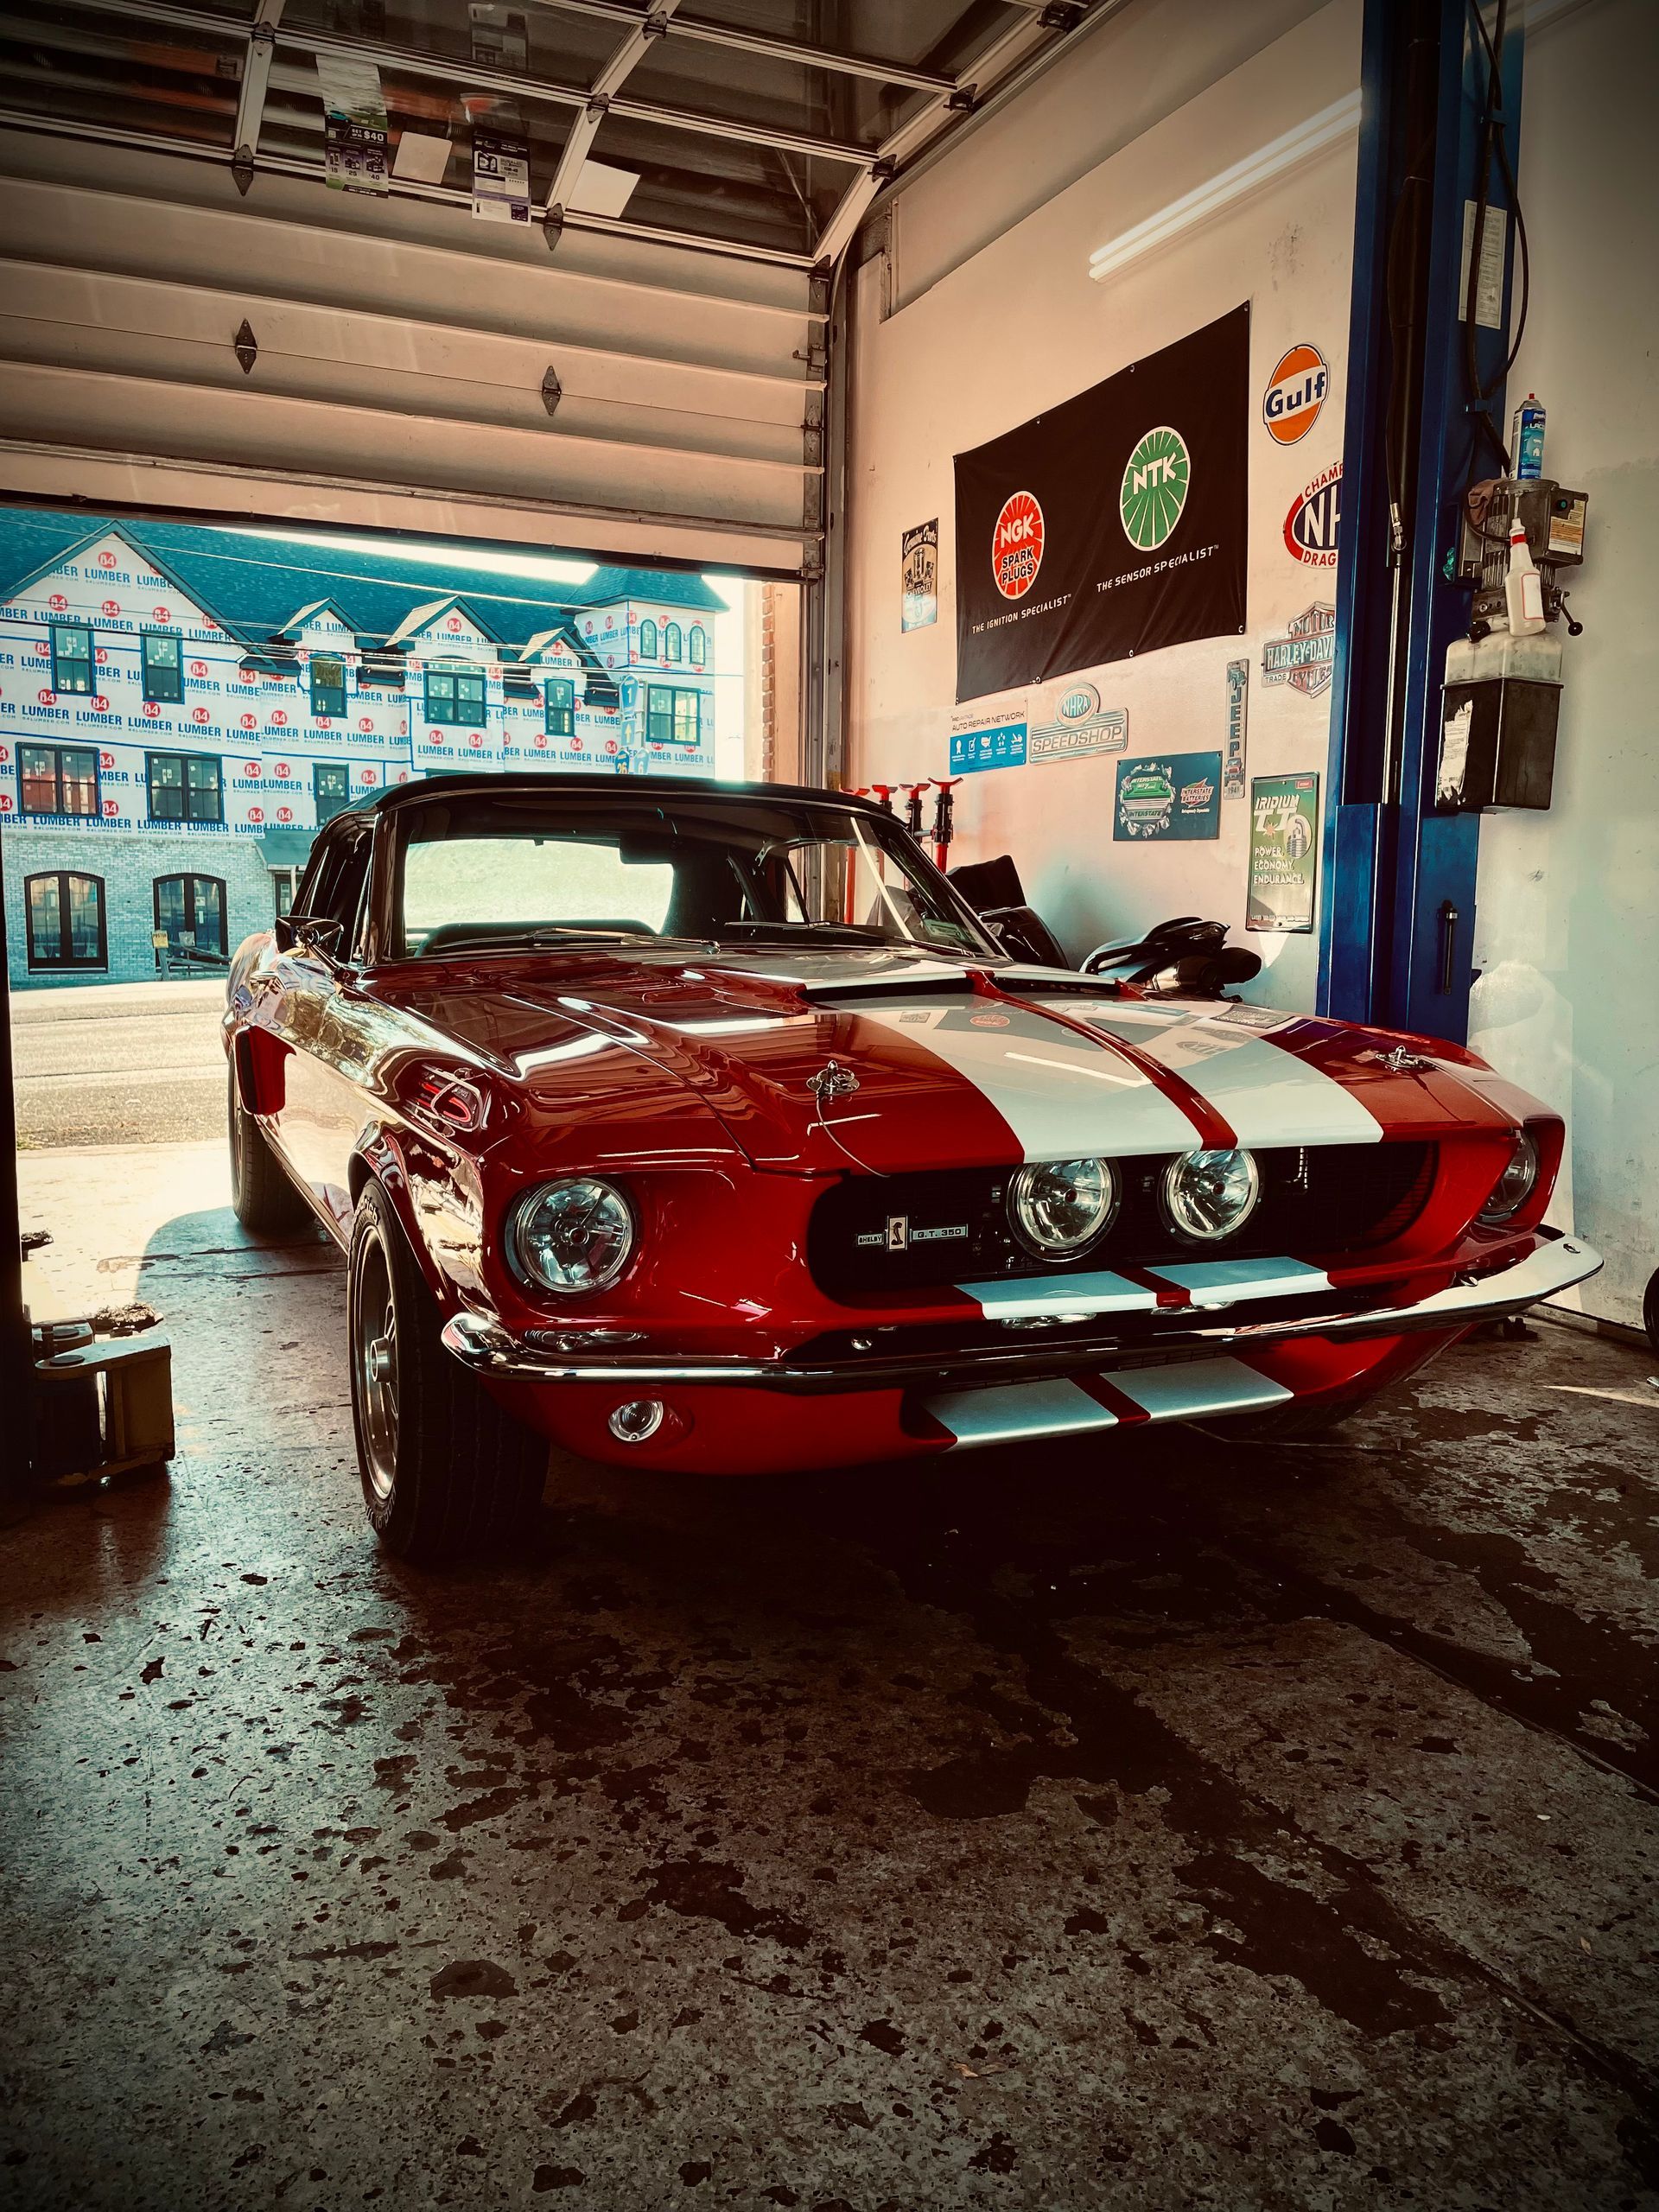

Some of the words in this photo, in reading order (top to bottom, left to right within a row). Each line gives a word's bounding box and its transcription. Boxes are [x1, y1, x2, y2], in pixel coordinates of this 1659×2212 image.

[364, 130, 385, 142] $40
[1265, 372, 1325, 419] Gulf
[1133, 451, 1177, 494] NTK
[1303, 484, 1342, 548] NH
[1000, 512, 1034, 549] NGK
[1001, 546, 1034, 571] SPARK
[85, 568, 130, 583] LUMBER
[1001, 562, 1034, 585] PLUGS
[1096, 577, 1114, 593] THE
[1114, 565, 1152, 587] SENSOR
[35, 611, 80, 623] LUMBER
[87, 617, 133, 631] LUMBER
[971, 621, 986, 635] THE
[986, 612, 1019, 630] IGNITION
[184, 677, 220, 691] UMBER
[1265, 672, 1287, 684] TRADE
[263, 681, 296, 693] UMBER
[626, 687, 632, 704] 1
[22, 705, 69, 720] LUMBER
[1063, 694, 1089, 717] NHRA
[76, 711, 122, 726] LUMBER
[128, 716, 172, 731] LUMBER
[594, 715, 620, 726] LUMBE
[952, 721, 968, 732] AUTO
[968, 716, 991, 729] REPAIR
[991, 710, 1026, 724] NETWORK
[1229, 688, 1242, 758] JEEP
[178, 722, 221, 737] LUMBER
[264, 726, 299, 738] UMBER
[303, 729, 342, 741] LUMBER
[346, 733, 385, 744] LUMBER
[1033, 725, 1122, 753] SPEEDSHOP
[418, 744, 454, 756] LUMBER
[458, 747, 493, 759] LUMBER
[524, 748, 556, 760] LUMBER
[560, 751, 592, 762] LUMBER
[675, 753, 703, 764] LUMBER
[100, 771, 128, 782] MBER
[264, 779, 302, 791] LUMBER
[1181, 787, 1212, 796] INTERSTATE
[1255, 793, 1300, 810] IRIDIUM
[34, 815, 80, 827] LUMBER
[86, 817, 131, 830] LUMBER
[138, 819, 181, 830] LUMBER
[1253, 806, 1298, 833] TT
[188, 822, 229, 833] LUMBER
[1254, 845, 1285, 859] POWER.
[1254, 859, 1295, 872] ECONOMY.
[1253, 873, 1305, 887] ENDURANCE.
[940, 1228, 963, 1236] 350
